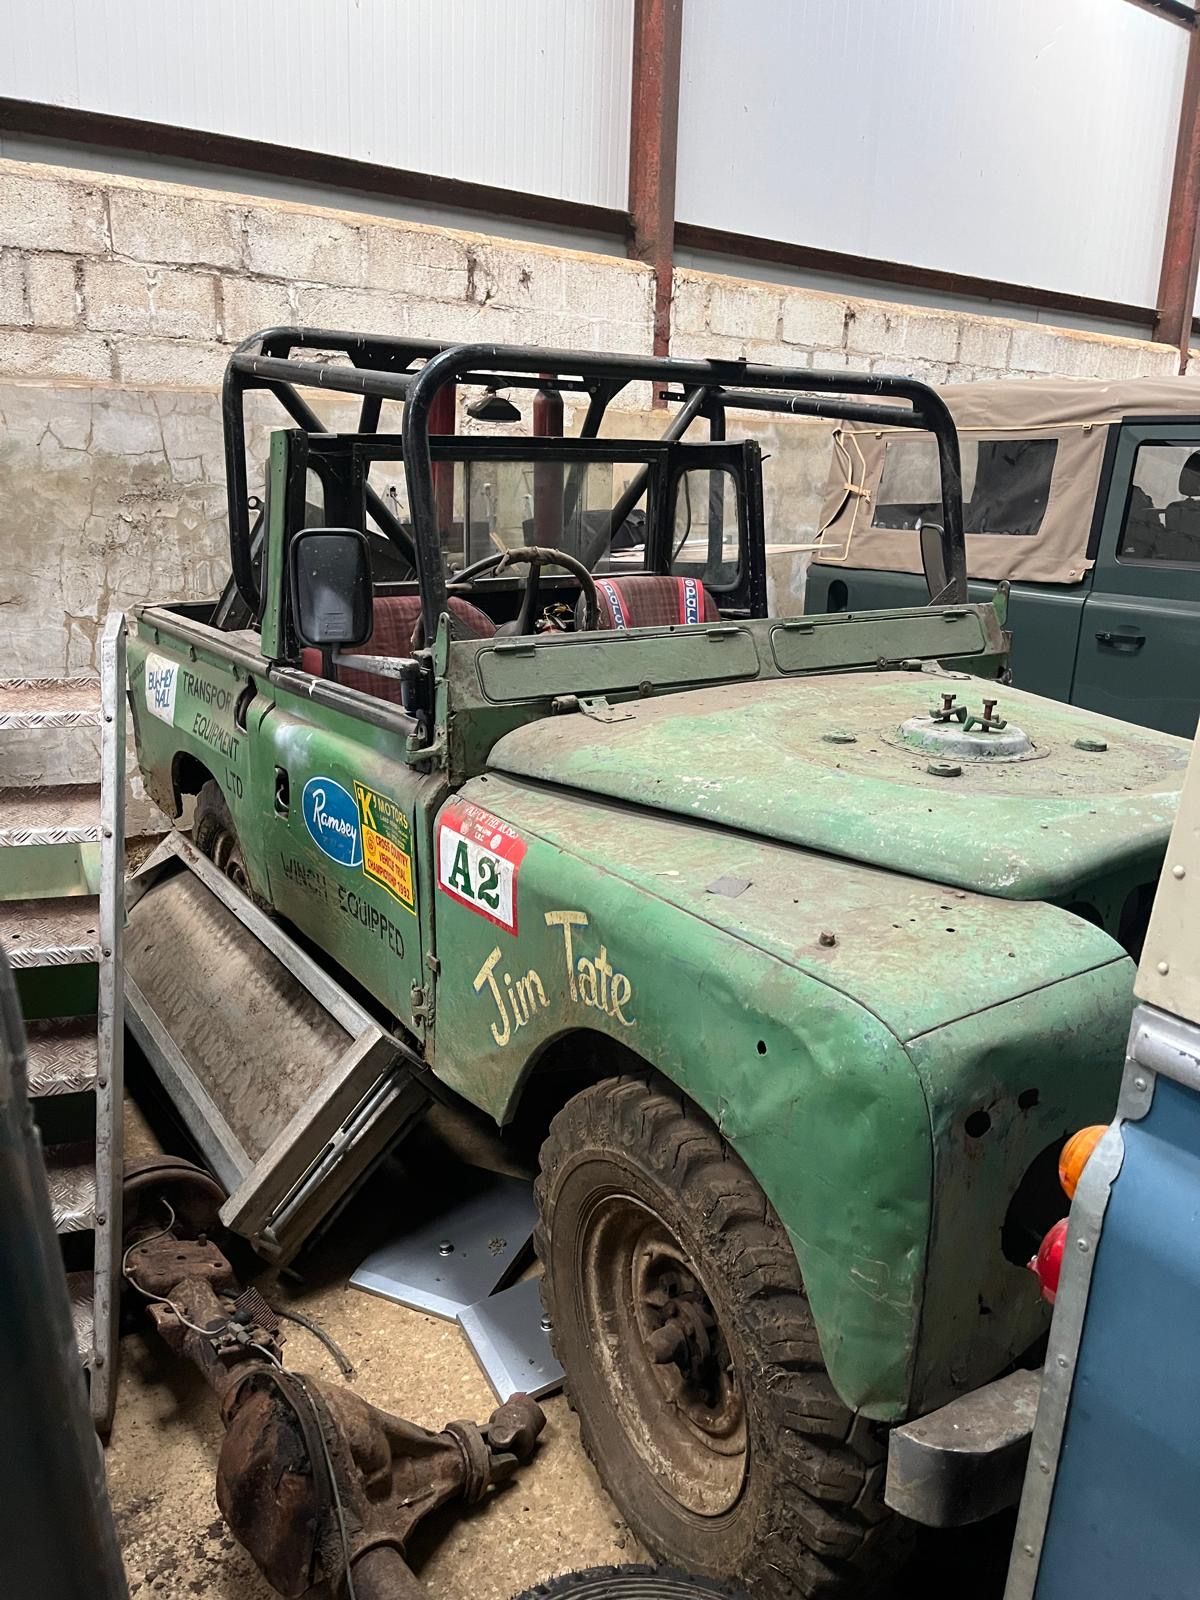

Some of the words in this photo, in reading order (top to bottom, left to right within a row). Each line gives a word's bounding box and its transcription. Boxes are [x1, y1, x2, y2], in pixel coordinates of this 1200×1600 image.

[183, 671, 234, 712] TRANSPOR
[193, 712, 239, 761] EQUIPMENT
[225, 767, 243, 799] LTD
[312, 788, 357, 864] Ramsey
[378, 798, 408, 829] MOTORS
[376, 835, 390, 852] CROSS
[391, 844, 408, 867] COUNTRY
[448, 840, 500, 910] A2
[338, 884, 405, 960] EQUIPPED
[473, 945, 550, 1046] Jim
[544, 910, 636, 1026] Tate
